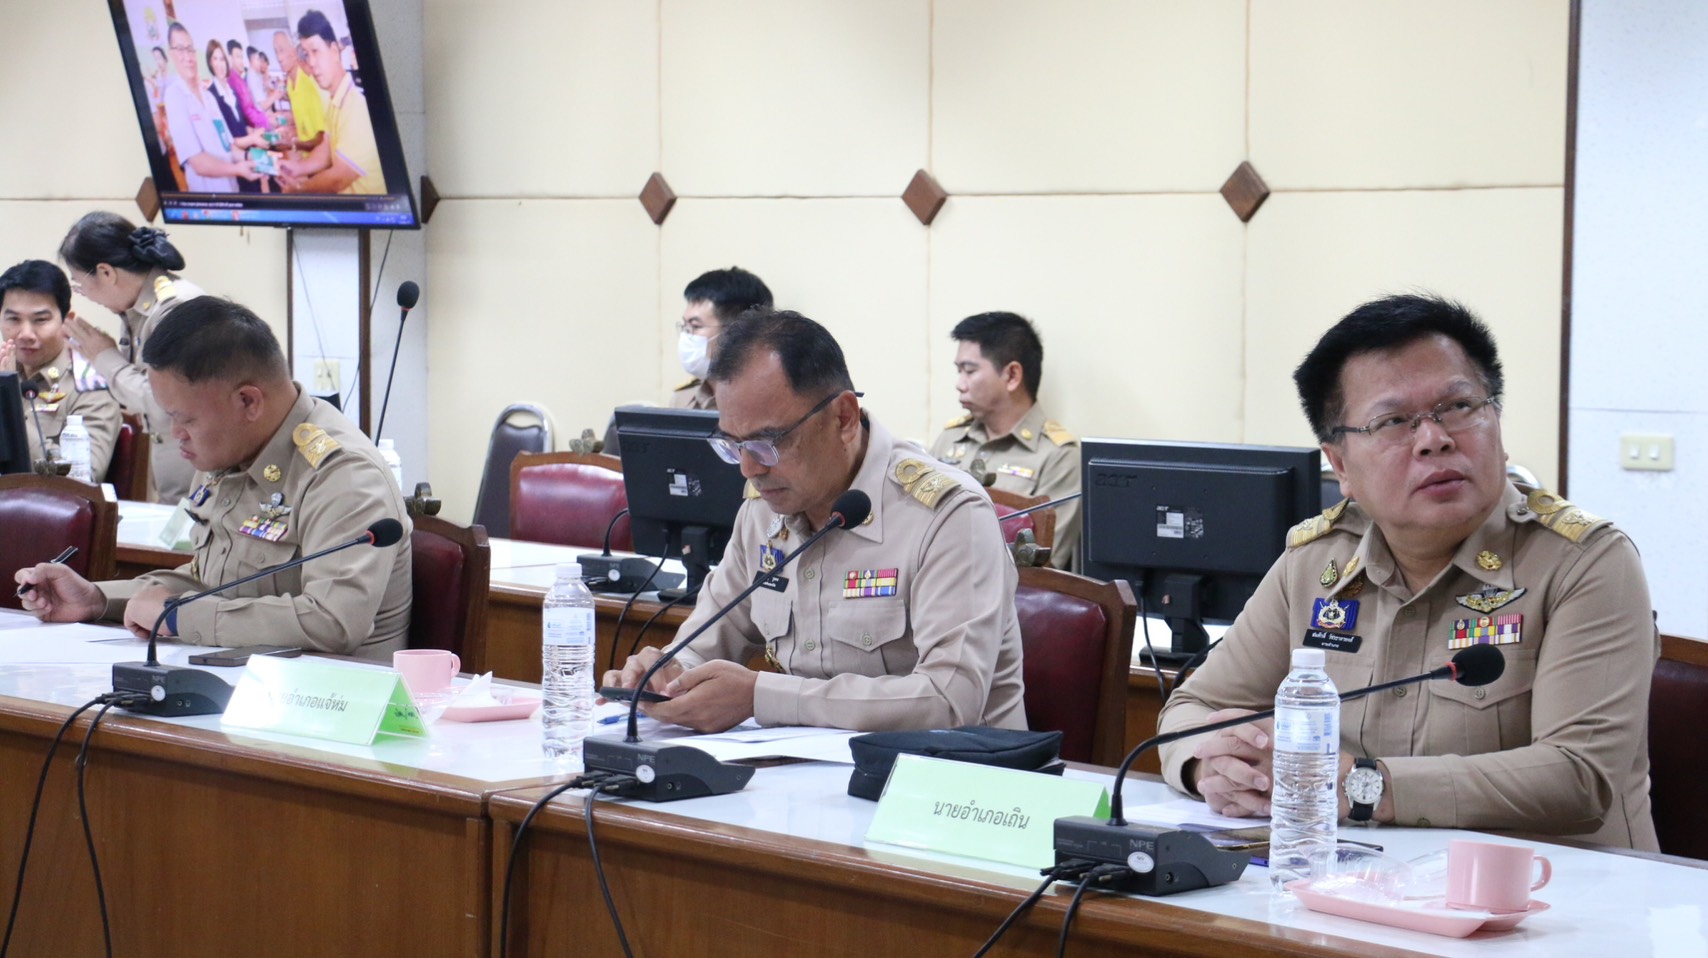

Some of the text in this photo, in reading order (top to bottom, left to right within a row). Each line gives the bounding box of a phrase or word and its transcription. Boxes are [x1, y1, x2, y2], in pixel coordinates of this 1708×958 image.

[637, 753, 656, 764] NPE
[933, 800, 1030, 830] นายอำเภอเถิน
[1129, 839, 1154, 850] NPE
